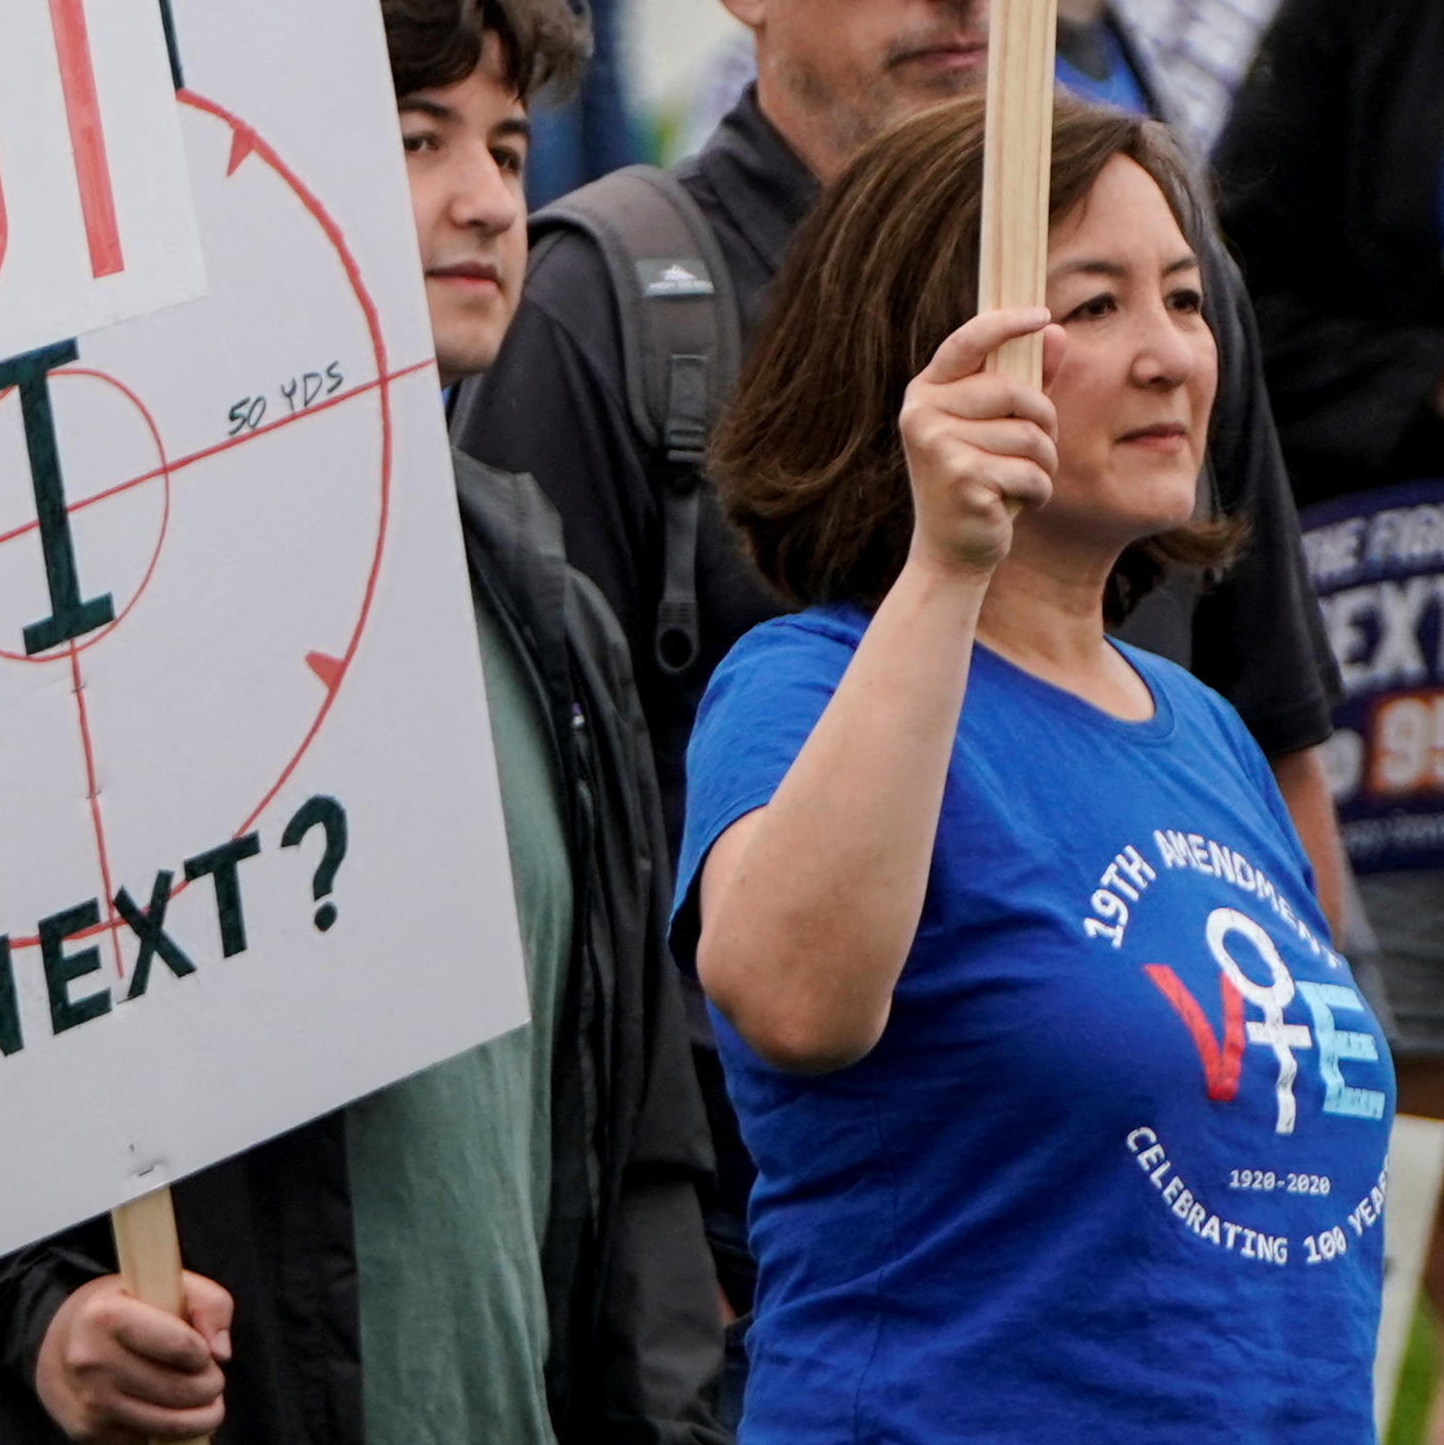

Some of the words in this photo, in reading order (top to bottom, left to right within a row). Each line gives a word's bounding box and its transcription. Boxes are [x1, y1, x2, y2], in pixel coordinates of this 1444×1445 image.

[228, 395, 267, 436] 50
[281, 360, 344, 412] YDS
[1083, 844, 1156, 949] 19TH
[1126, 1126, 1288, 1266] CELEBRATING
[1303, 1225, 1347, 1264] 100
[1229, 1169, 1331, 1196] 1920-2020
